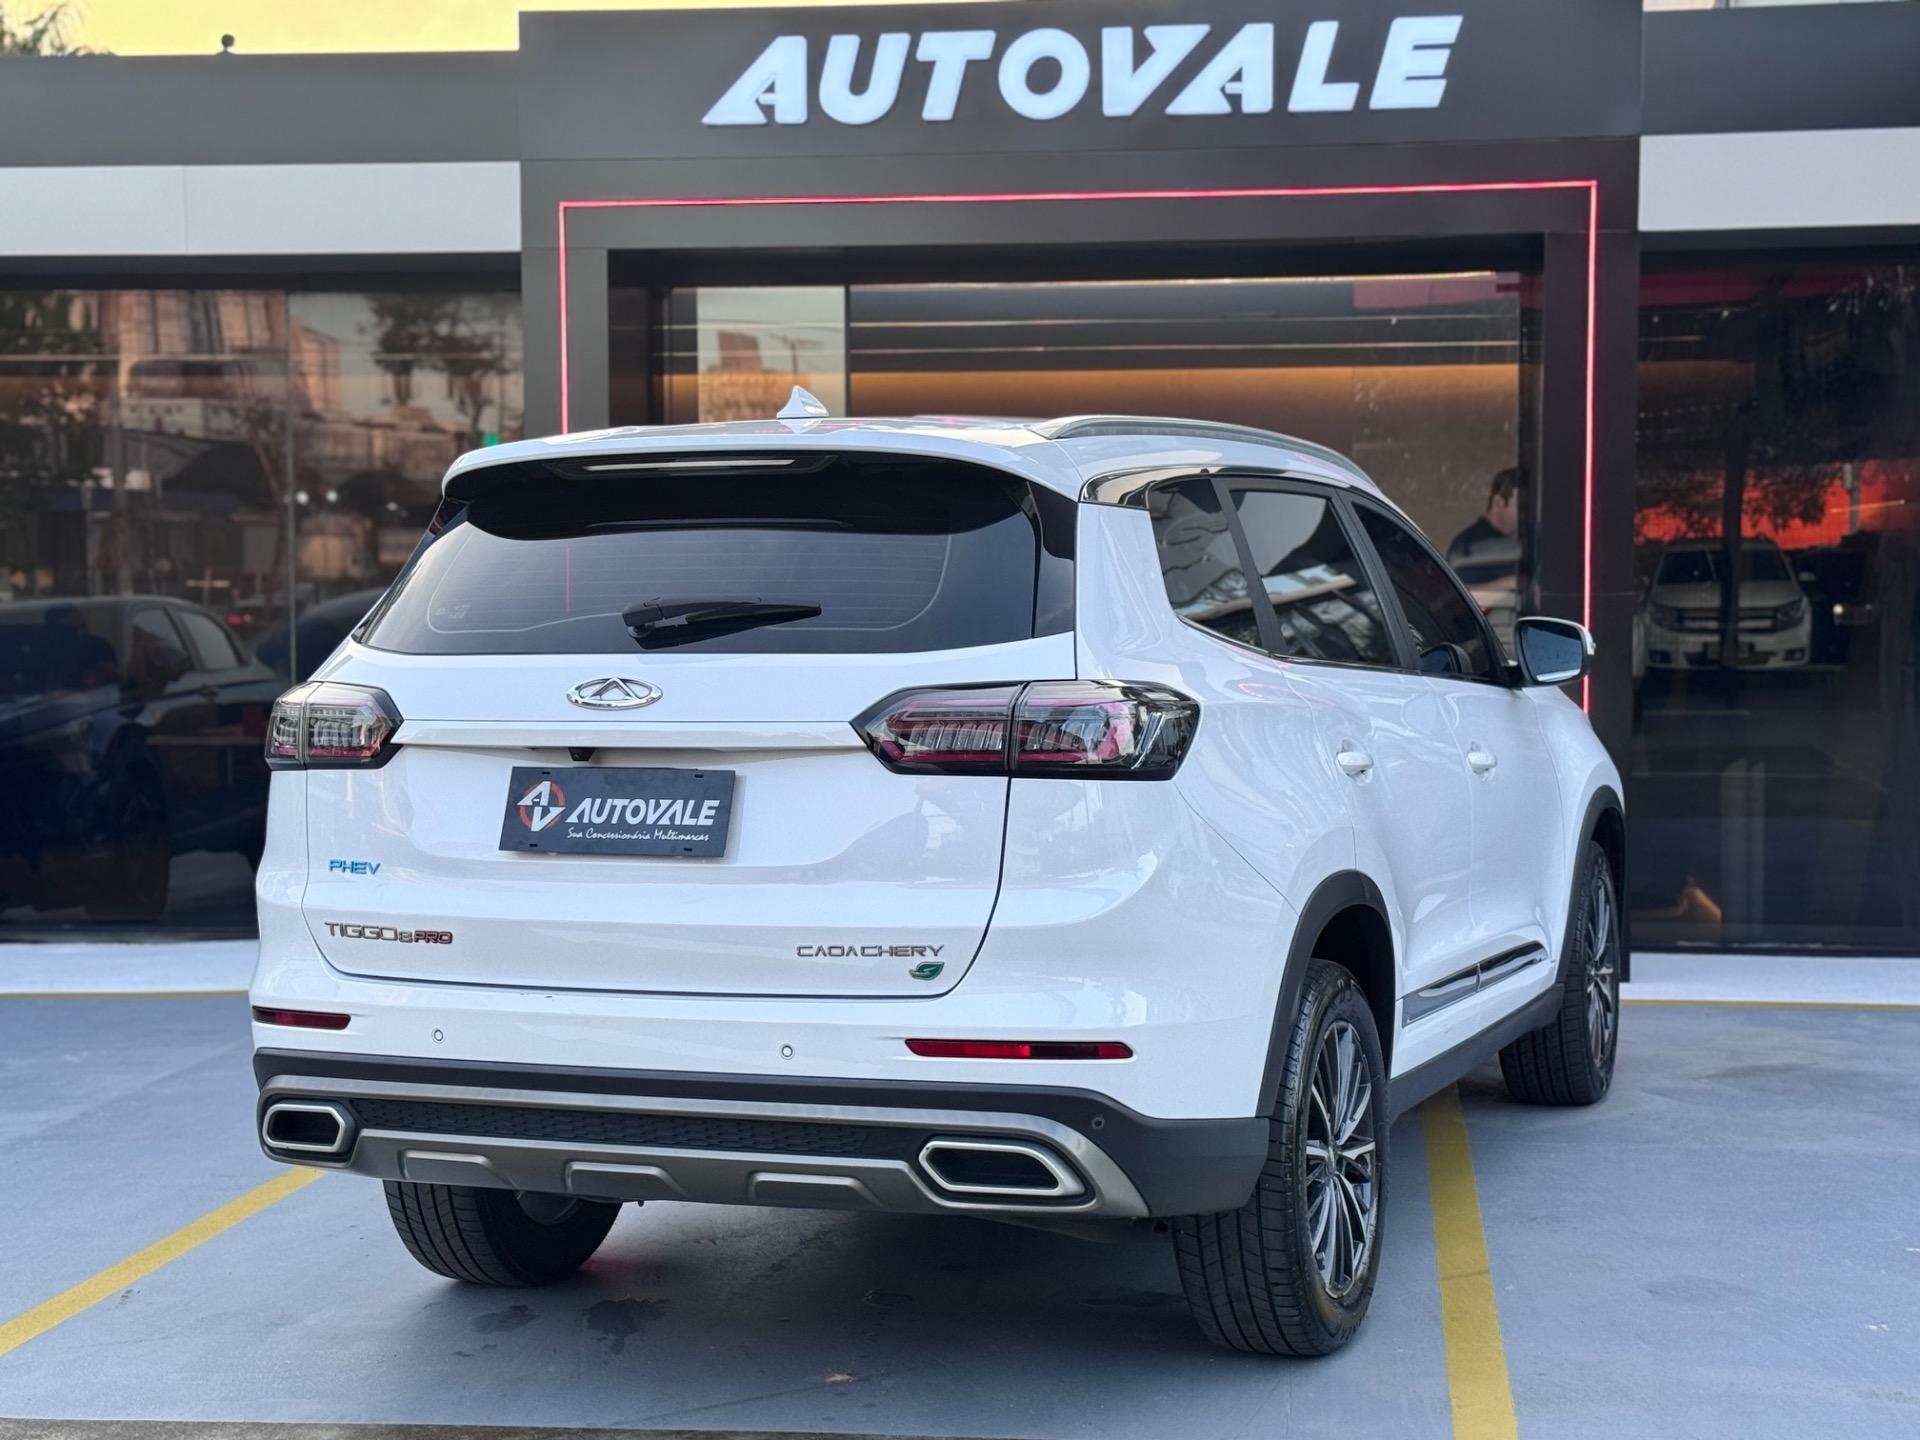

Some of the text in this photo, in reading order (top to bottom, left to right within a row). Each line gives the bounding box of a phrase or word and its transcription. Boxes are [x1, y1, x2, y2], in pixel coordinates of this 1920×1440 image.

[701, 14, 1464, 126] AUTOVALE
[565, 797, 721, 826] AUTOVALE
[567, 826, 710, 842] Sua Concessionária Multimarcas
[328, 859, 382, 875] PHEV
